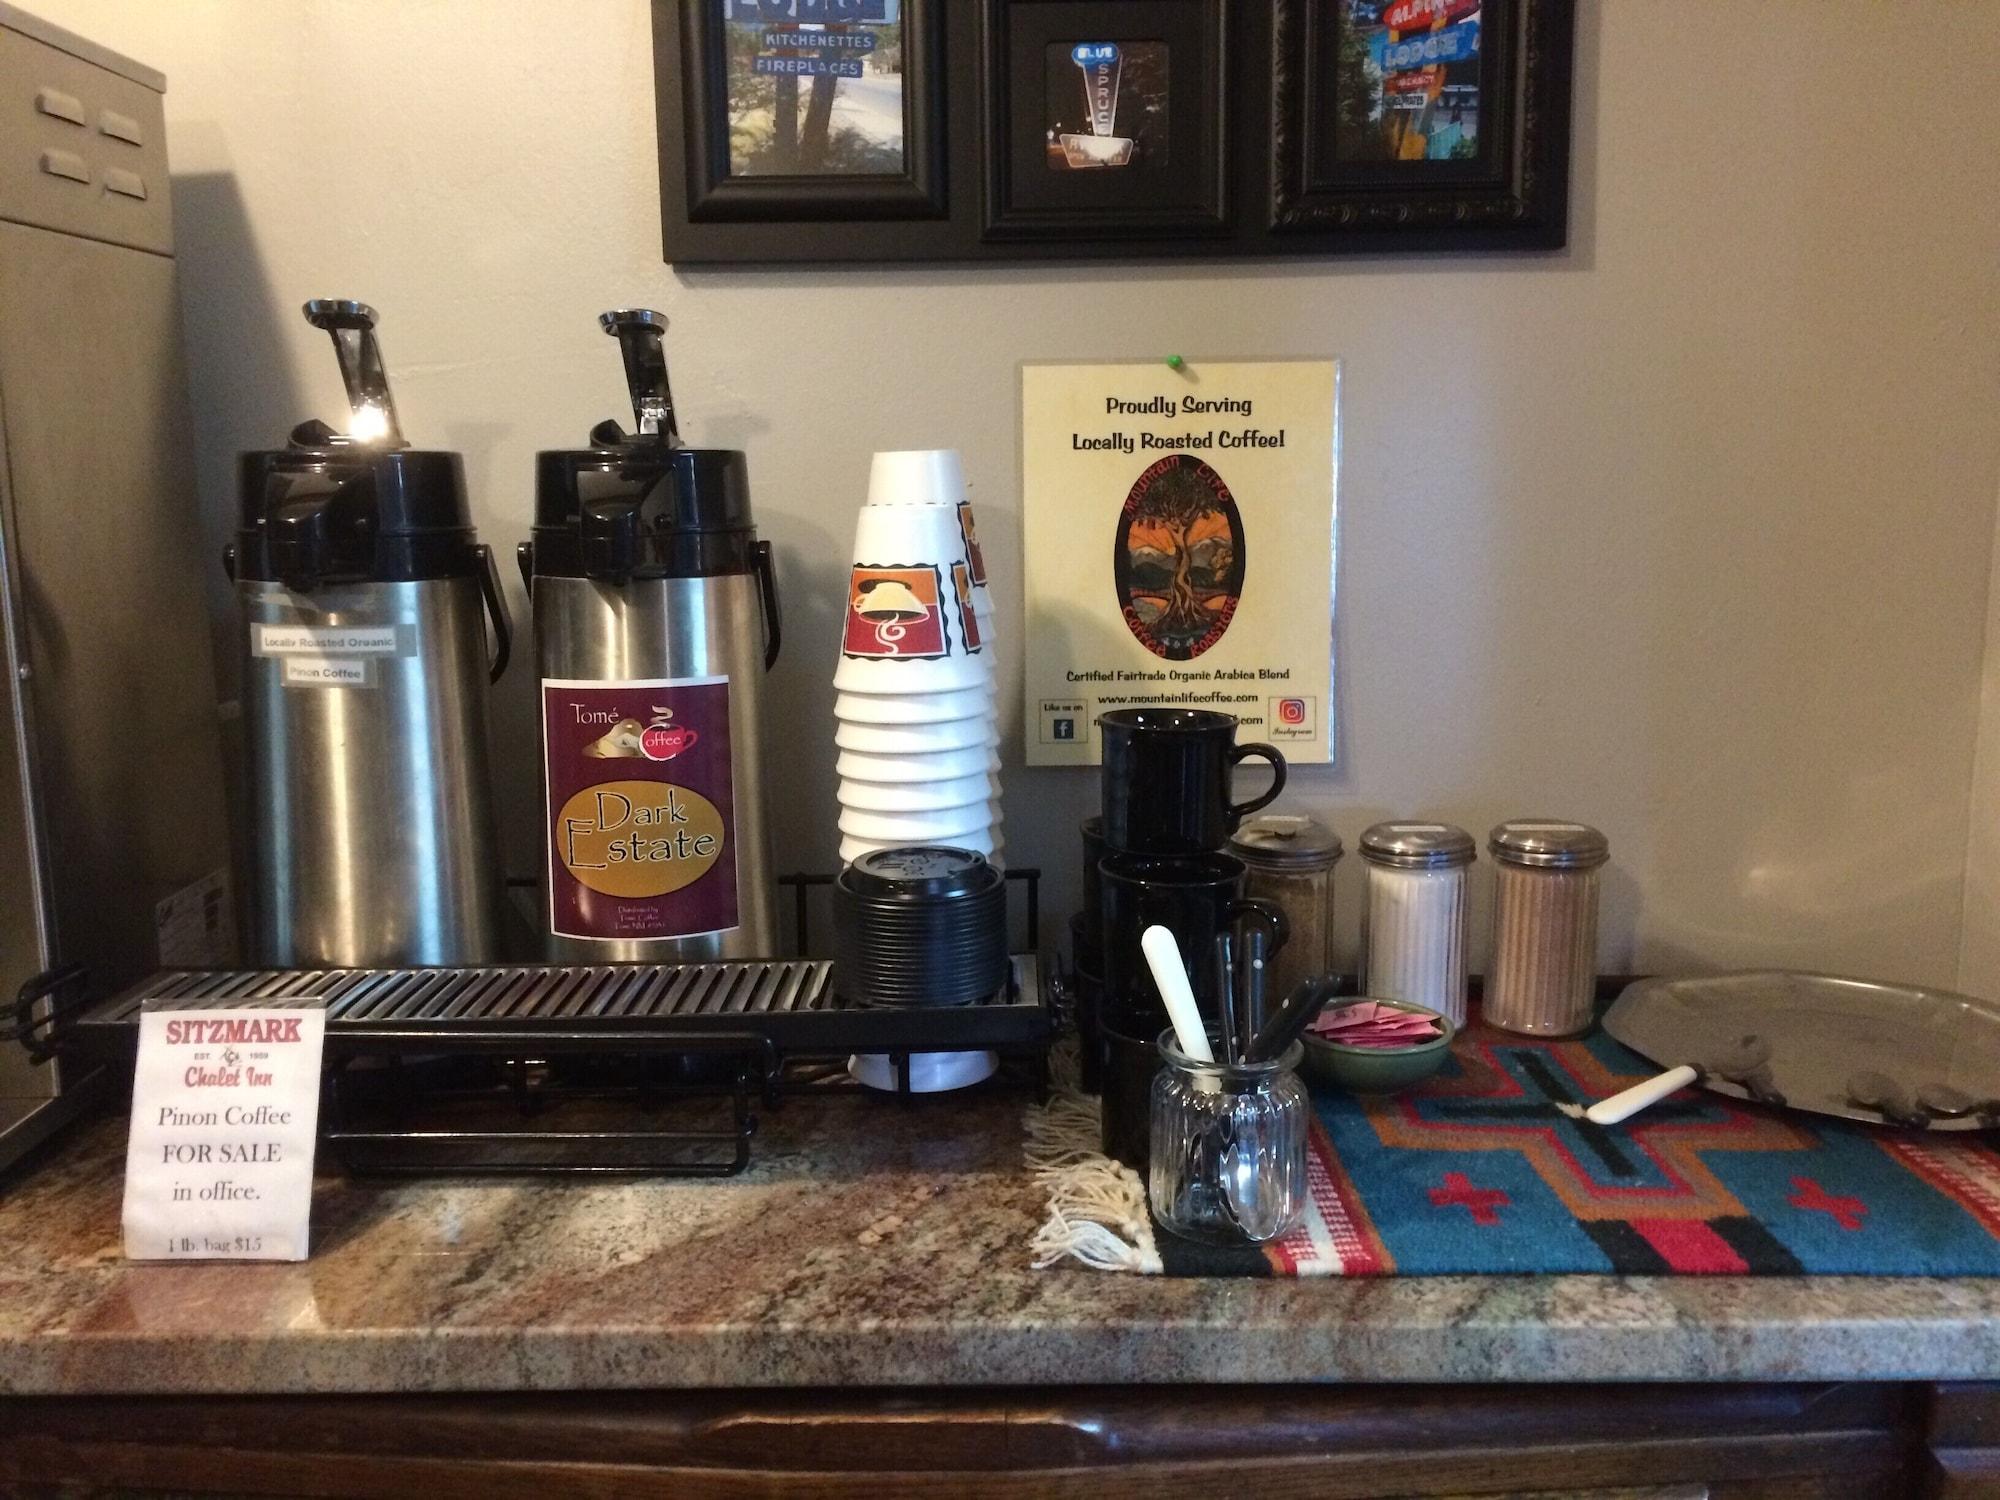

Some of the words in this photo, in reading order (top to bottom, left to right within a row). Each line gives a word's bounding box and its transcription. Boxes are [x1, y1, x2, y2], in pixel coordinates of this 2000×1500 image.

[765, 33, 872, 48] KITCHENETTES
[1385, 31, 1457, 67] LODGE
[1077, 47, 1113, 59] BLUE
[756, 59, 859, 75] FIREPLACES
[1106, 397, 1176, 417] Proudly
[1182, 396, 1252, 416] Serving
[1072, 432, 1134, 453] Locally
[1141, 431, 1212, 450] Roasted
[1218, 430, 1285, 449] Coffee!
[264, 637, 296, 648] Locally
[299, 638, 345, 648] Roasted
[322, 669, 361, 680] Coffee
[1066, 671, 1114, 682] Certified
[1117, 671, 1166, 682] Fairtrade
[1169, 669, 1211, 684] Organic
[1214, 669, 1255, 681] Arabica
[1258, 669, 1290, 680] Blend
[1044, 704, 1060, 712] Like
[1098, 692, 1259, 704] www.mountainlifecoffee.com
[570, 703, 619, 725] Tomé
[595, 788, 689, 832] Dark
[565, 818, 717, 870] Estate
[166, 1018, 303, 1045] SITZMARK
[184, 1066, 241, 1088] Chalet
[246, 1066, 273, 1087] Inn
[157, 1107, 217, 1126] Pinon
[225, 1105, 292, 1126] Coffee
[162, 1144, 213, 1164] FOR
[218, 1143, 282, 1163] SALE
[172, 1181, 192, 1201] in
[199, 1181, 261, 1201] office.
[204, 1237, 231, 1254] bag
[234, 1236, 262, 1251] $15
